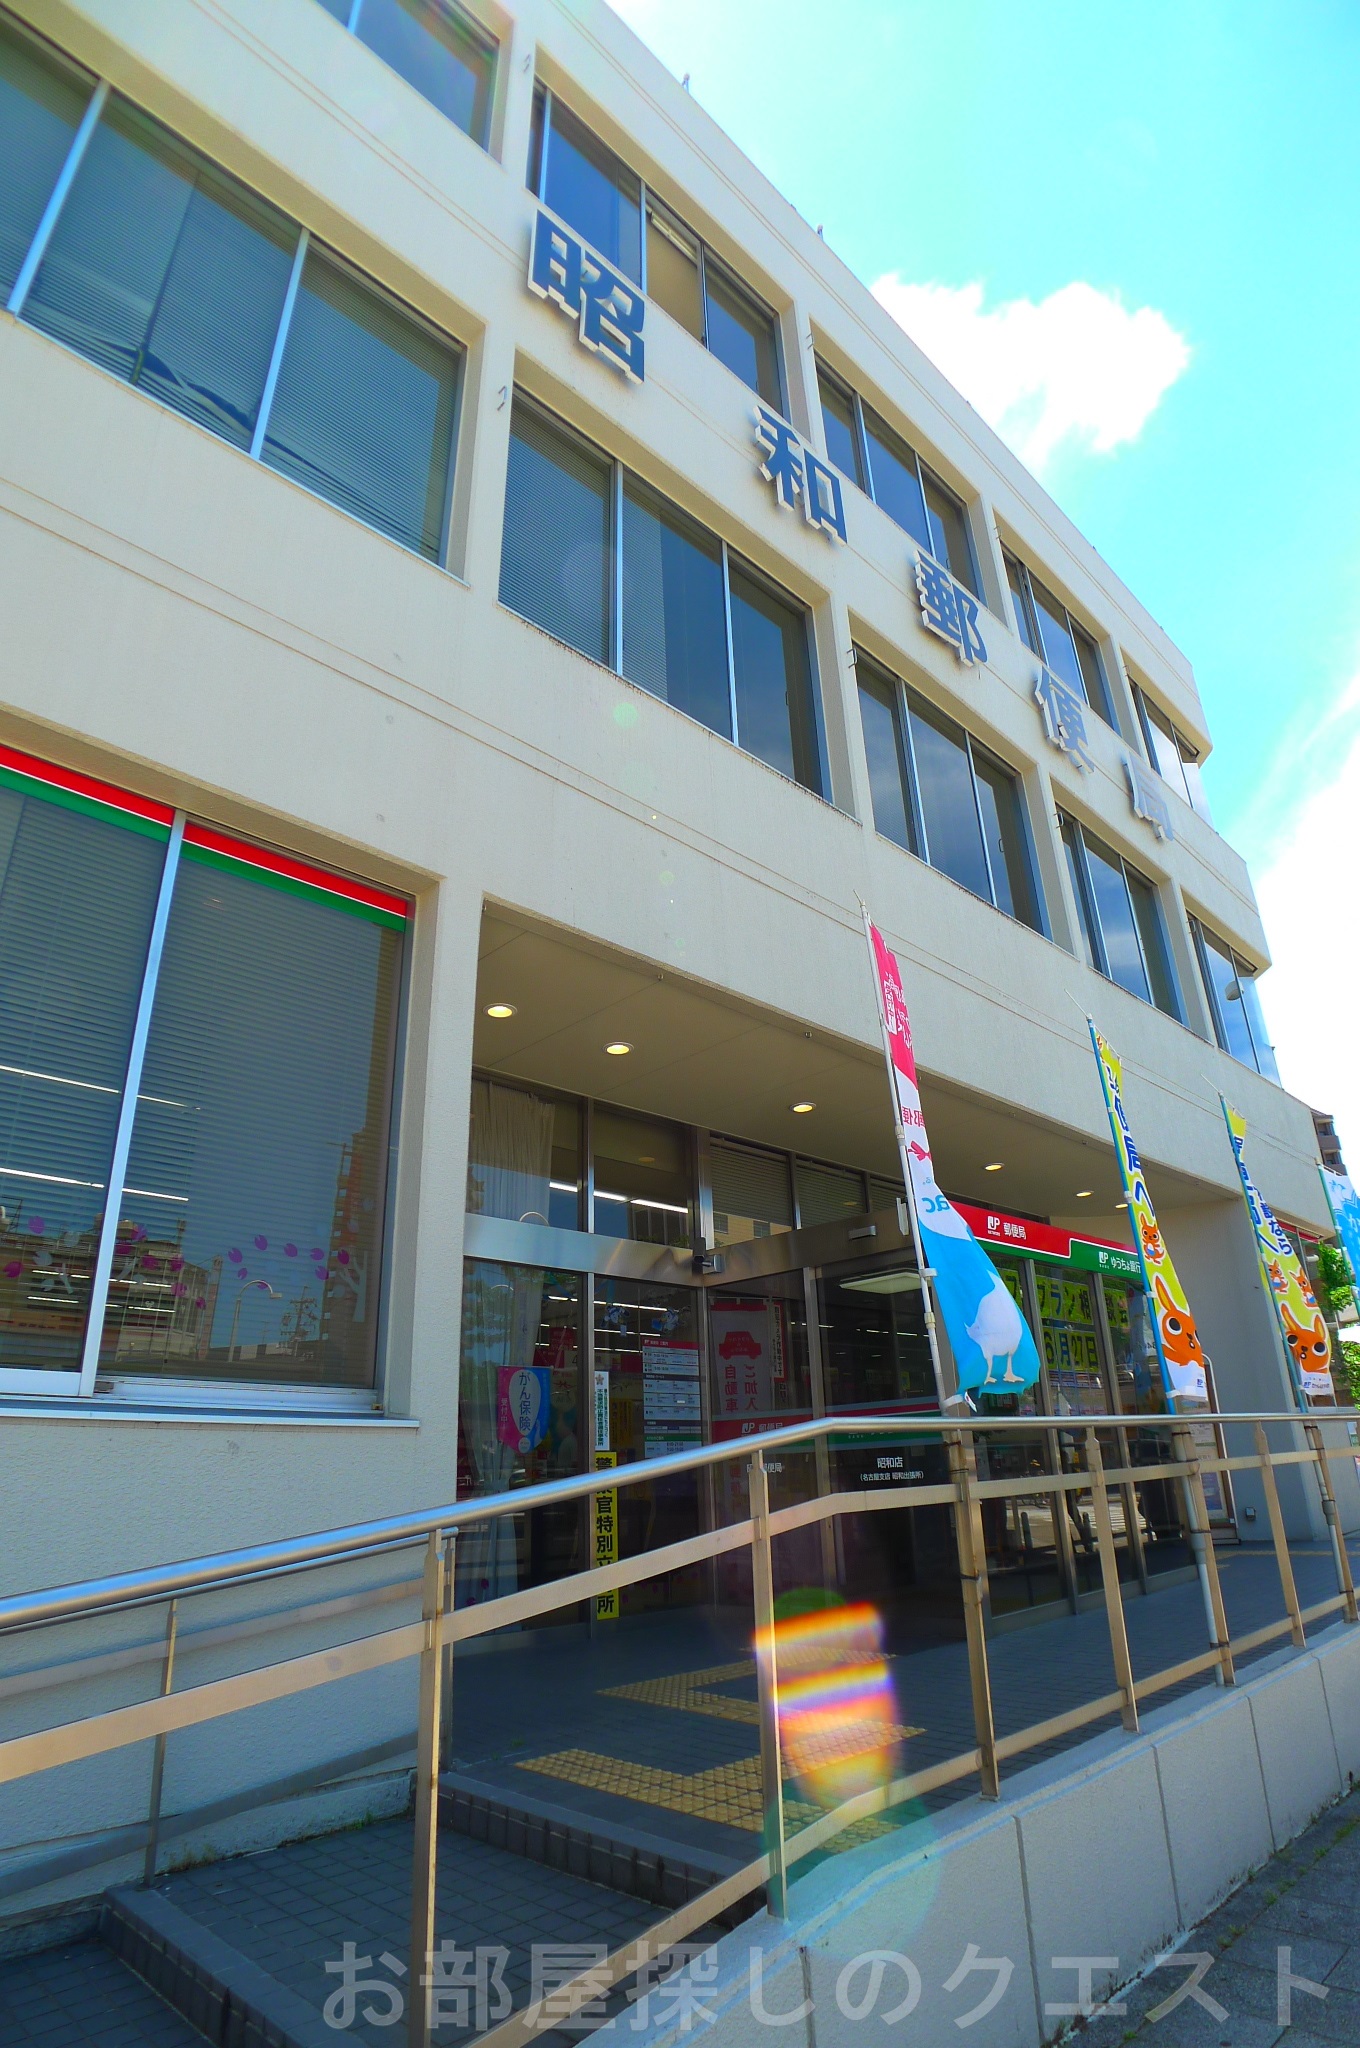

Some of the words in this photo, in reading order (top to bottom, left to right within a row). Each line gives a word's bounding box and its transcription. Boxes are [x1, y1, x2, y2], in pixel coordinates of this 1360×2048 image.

[528, 208, 1174, 841] 昭和郵便局
[1003, 1222, 1027, 1241] 郵便局
[1110, 1256, 1141, 1274] ゆうちょ銀行
[519, 1371, 531, 1431] がん保険
[725, 1364, 738, 1413] 自動車
[745, 1363, 757, 1411] ご加入
[876, 1456, 904, 1469] 昭和店
[596, 1457, 614, 1613] 警官特別立所
